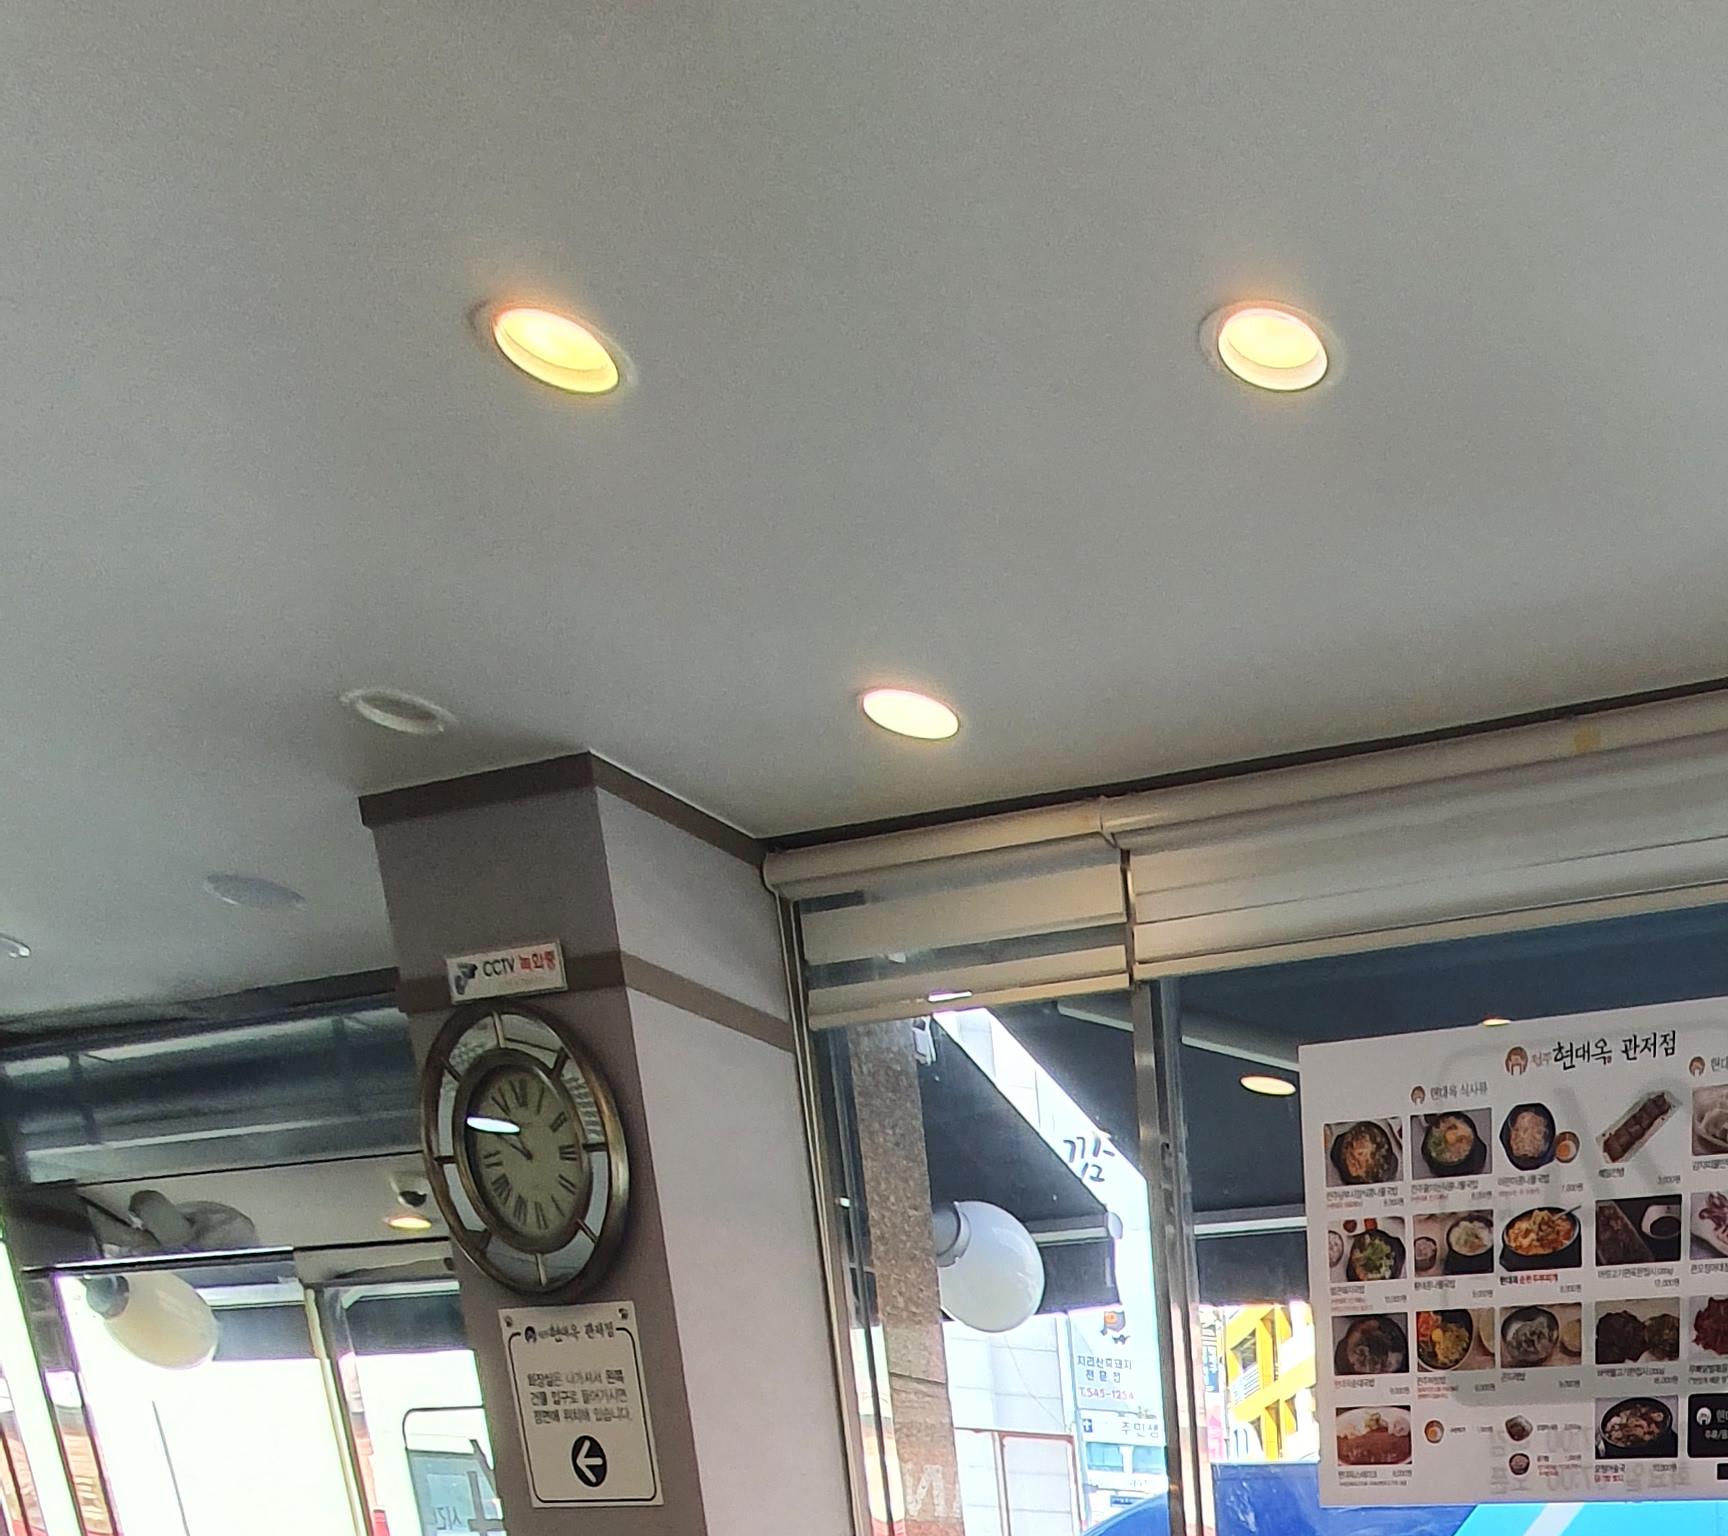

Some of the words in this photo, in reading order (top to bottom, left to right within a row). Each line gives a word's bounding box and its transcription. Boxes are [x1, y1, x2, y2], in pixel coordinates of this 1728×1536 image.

[482, 956, 516, 977] CCTV
[1552, 1038, 1612, 1070] 현대옥
[1621, 1030, 1677, 1061] 관저점
[527, 1371, 562, 1388] 화장실은
